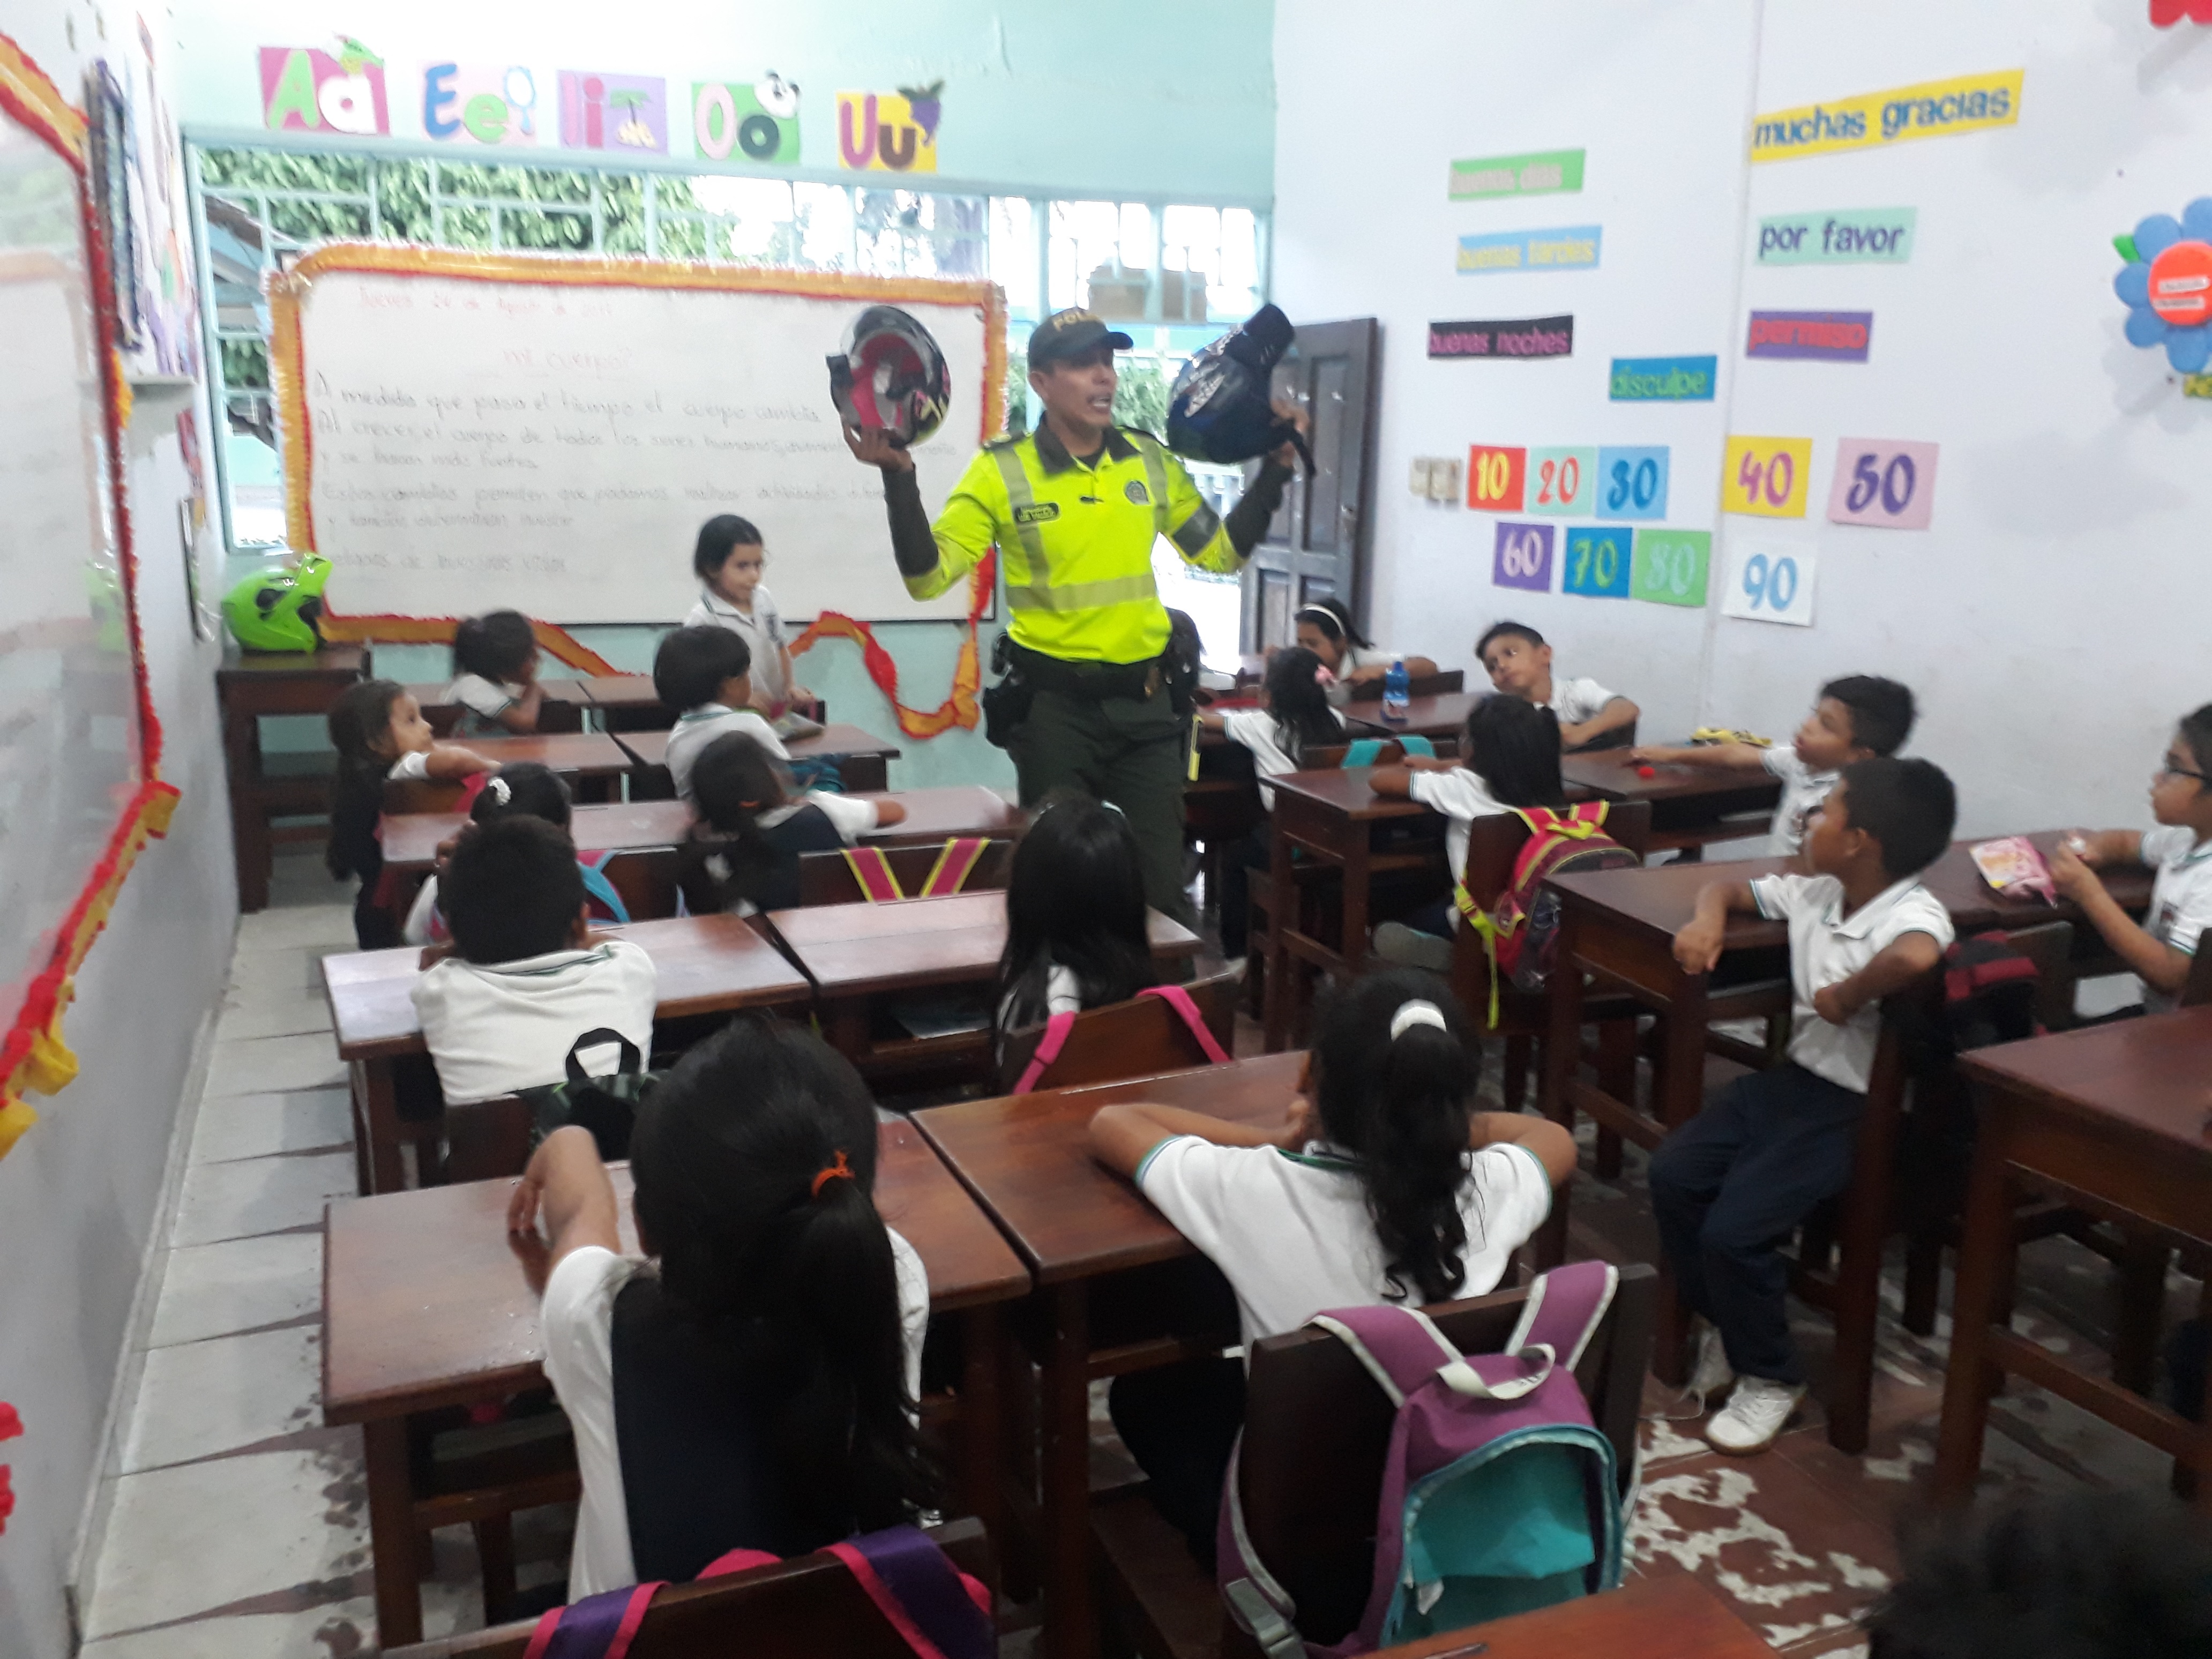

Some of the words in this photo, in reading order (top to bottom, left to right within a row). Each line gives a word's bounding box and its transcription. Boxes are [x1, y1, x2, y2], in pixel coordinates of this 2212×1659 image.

[425, 63, 510, 144] Ee
[695, 83, 780, 161] Oo
[840, 94, 915, 170] Uu
[1753, 106, 1866, 148] muchas
[1881, 87, 2010, 139] gracias
[1758, 222, 1808, 260] por
[1822, 218, 1905, 255] favor
[1748, 315, 1867, 350] permiso
[1475, 447, 1510, 502] 10
[1536, 455, 1580, 505] 20
[1738, 451, 1793, 507] 40
[1847, 453, 1917, 515] 50
[1502, 529, 1544, 578] 60
[1573, 538, 1618, 588] 70
[1644, 541, 1695, 596] 80
[1742, 553, 1798, 612] 90
